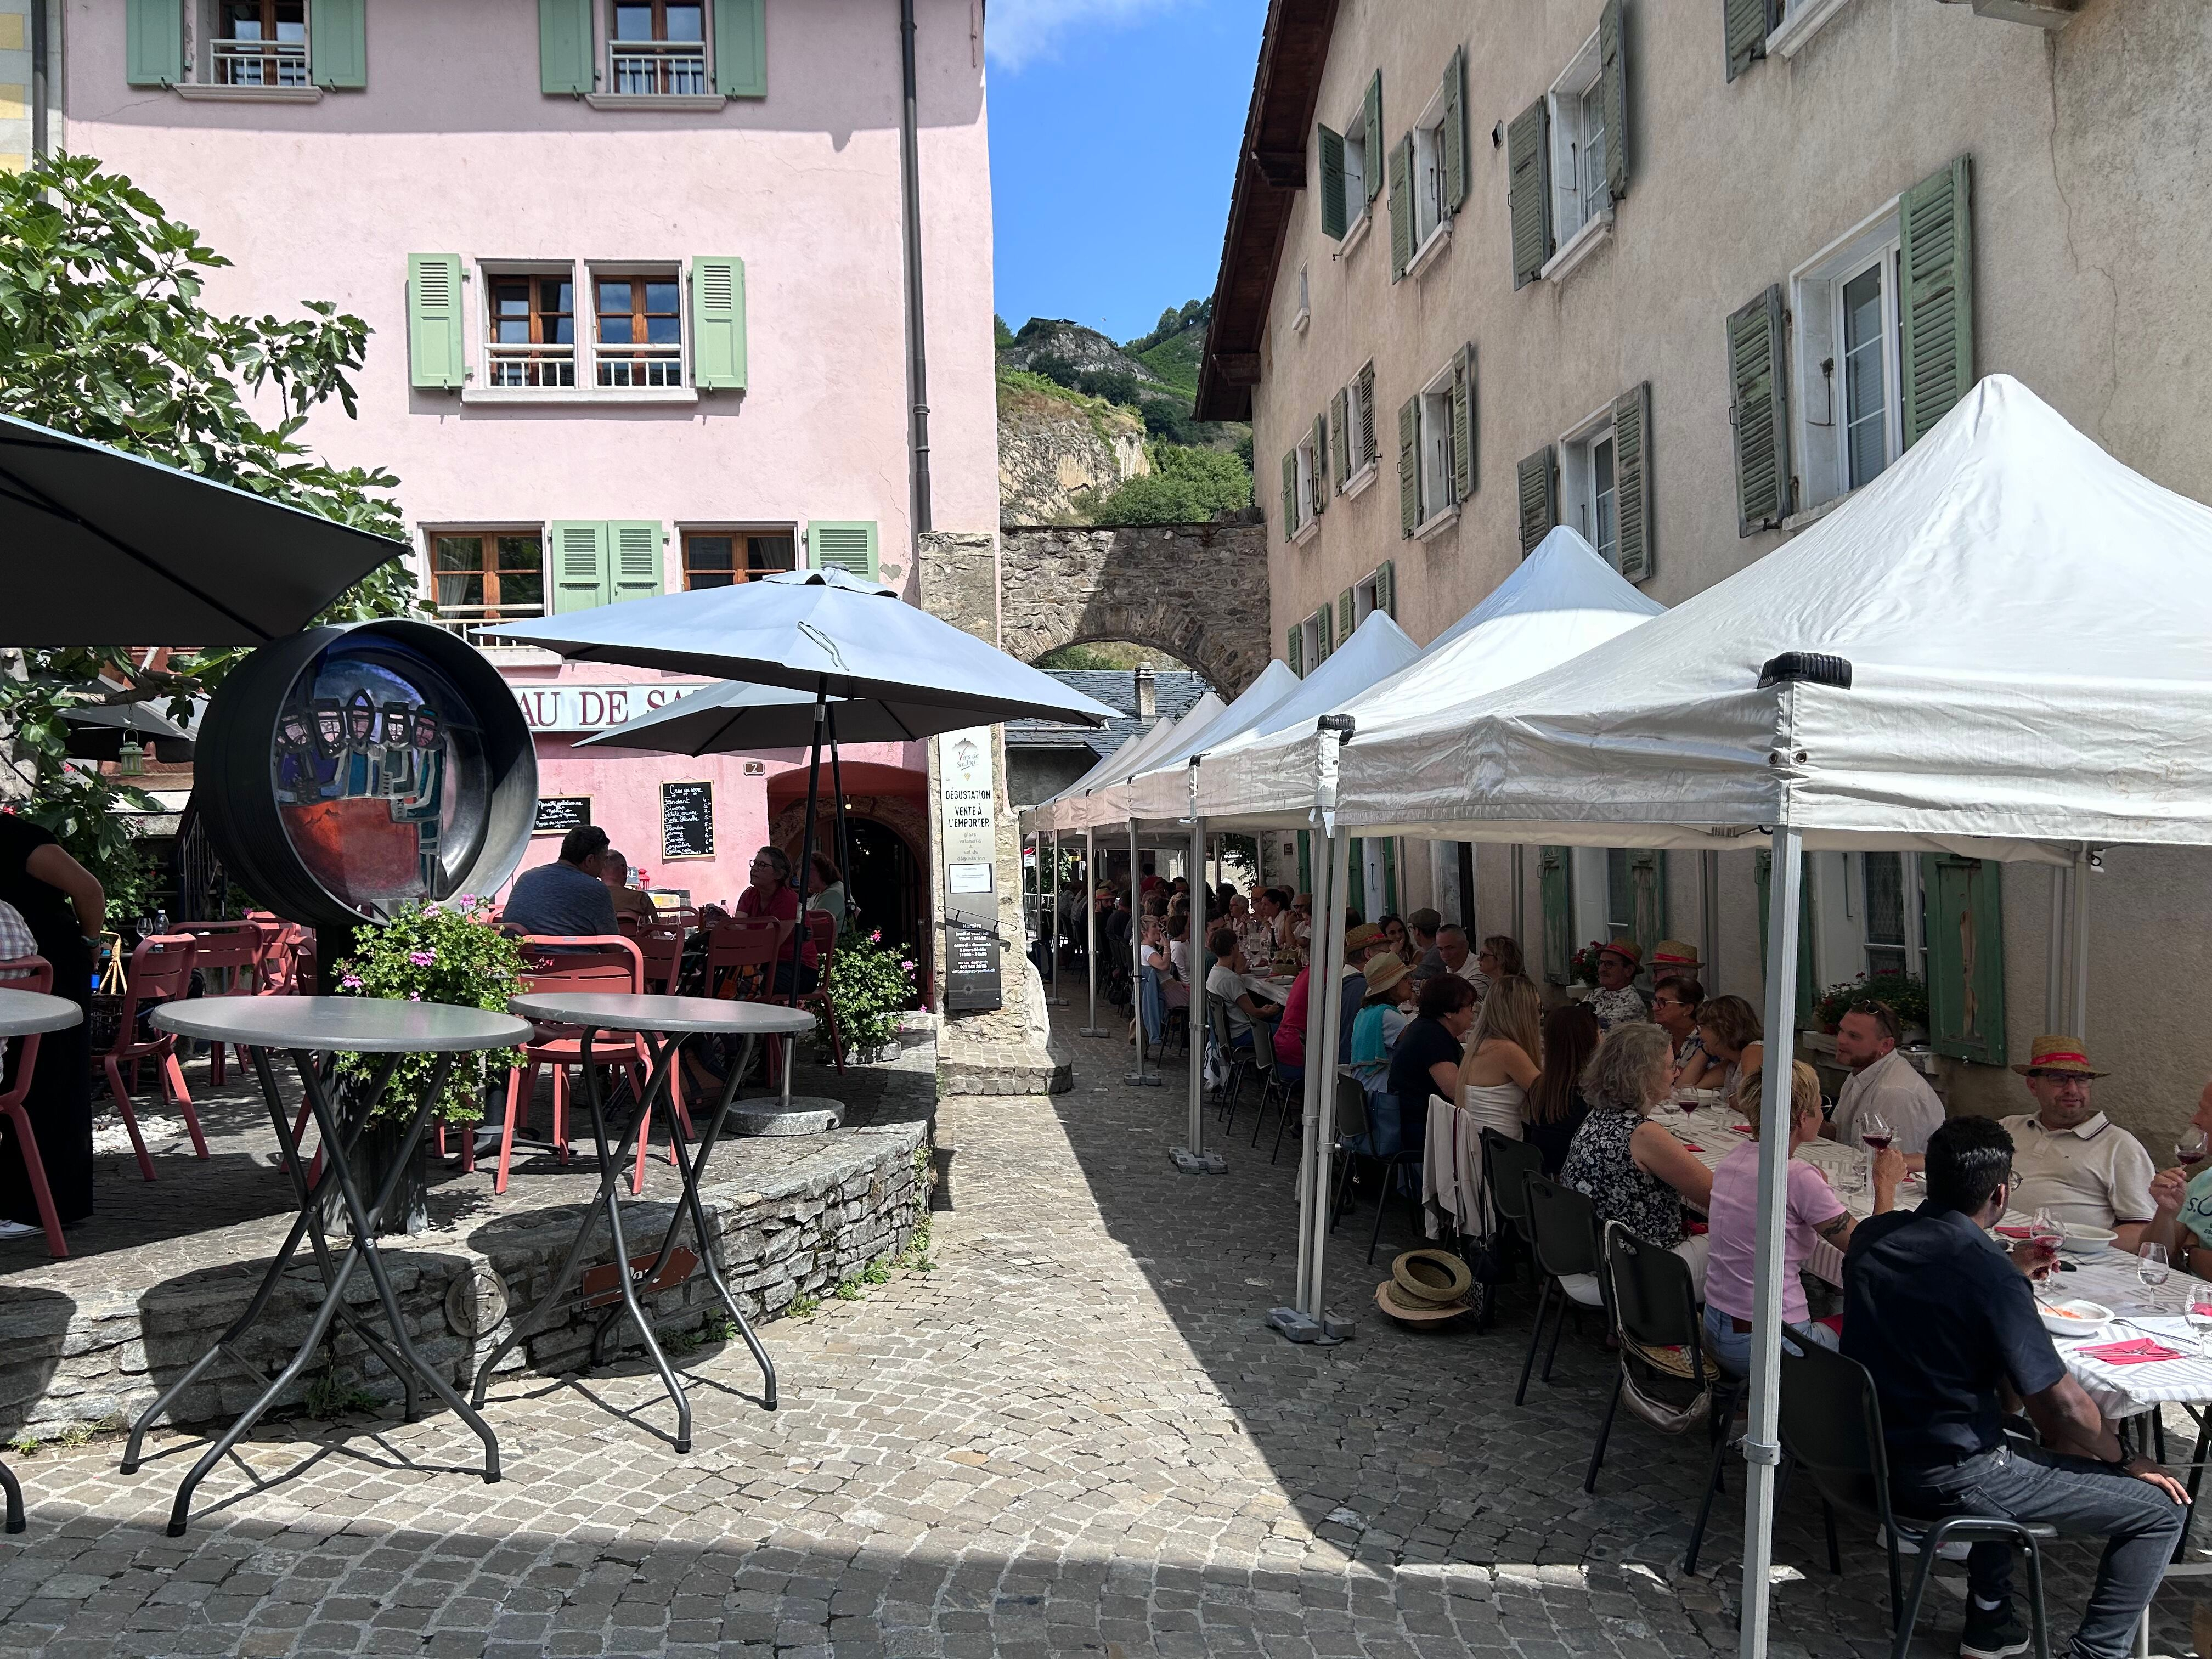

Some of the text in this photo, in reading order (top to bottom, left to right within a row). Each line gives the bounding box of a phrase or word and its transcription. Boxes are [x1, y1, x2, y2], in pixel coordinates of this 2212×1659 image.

[579, 691, 628, 725] DE
[958, 747, 970, 761] Vins
[752, 764, 757, 772] 2
[957, 759, 976, 768] Saillon
[946, 787, 990, 799] DÉGUSTATION
[955, 803, 982, 816] VENTE À
[949, 818, 989, 827] L'EMPORTER
